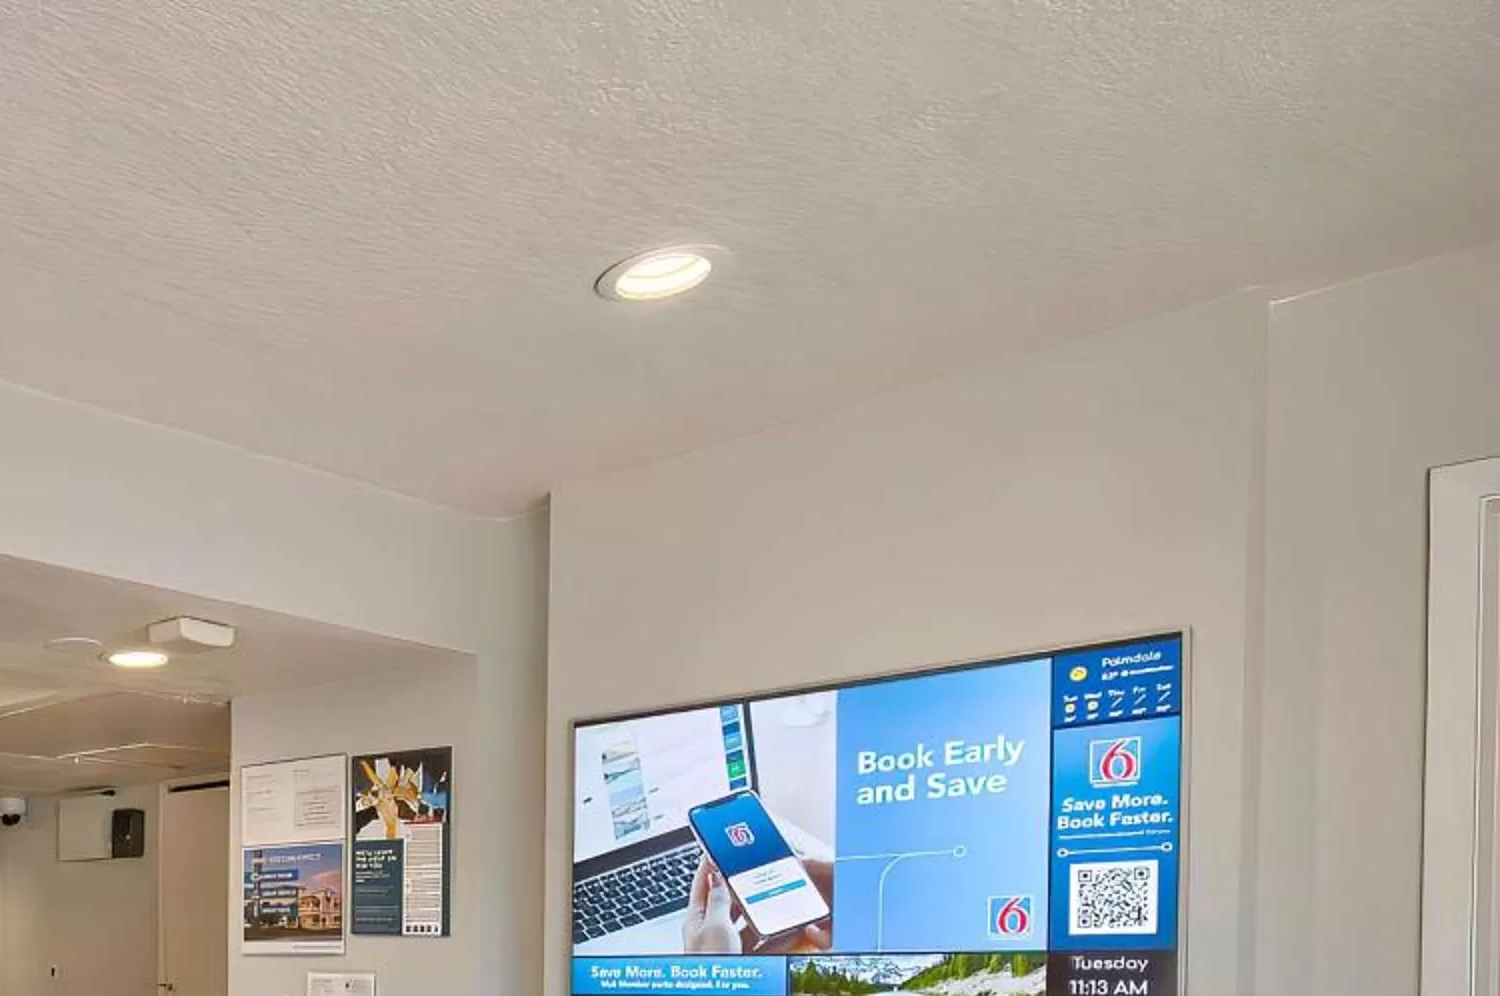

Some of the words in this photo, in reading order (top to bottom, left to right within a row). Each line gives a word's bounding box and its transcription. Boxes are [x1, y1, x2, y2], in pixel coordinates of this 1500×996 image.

[858, 743, 935, 775] Book
[944, 733, 1026, 767] Early
[1100, 737, 1137, 783] 6
[856, 773, 916, 805] and
[926, 772, 1008, 799] Save
[1061, 797, 1106, 813] Save
[1111, 794, 1168, 809] More.
[1057, 813, 1105, 830] Book
[1110, 811, 1173, 827] Faster.
[997, 896, 1030, 935] 6
[591, 965, 621, 979] Save
[625, 965, 666, 978] More.
[671, 965, 708, 978] Book
[711, 965, 763, 978] Faster.
[1071, 955, 1149, 972] Tuesday
[1070, 979, 1109, 996] 11:13
[1113, 979, 1149, 996] AM
